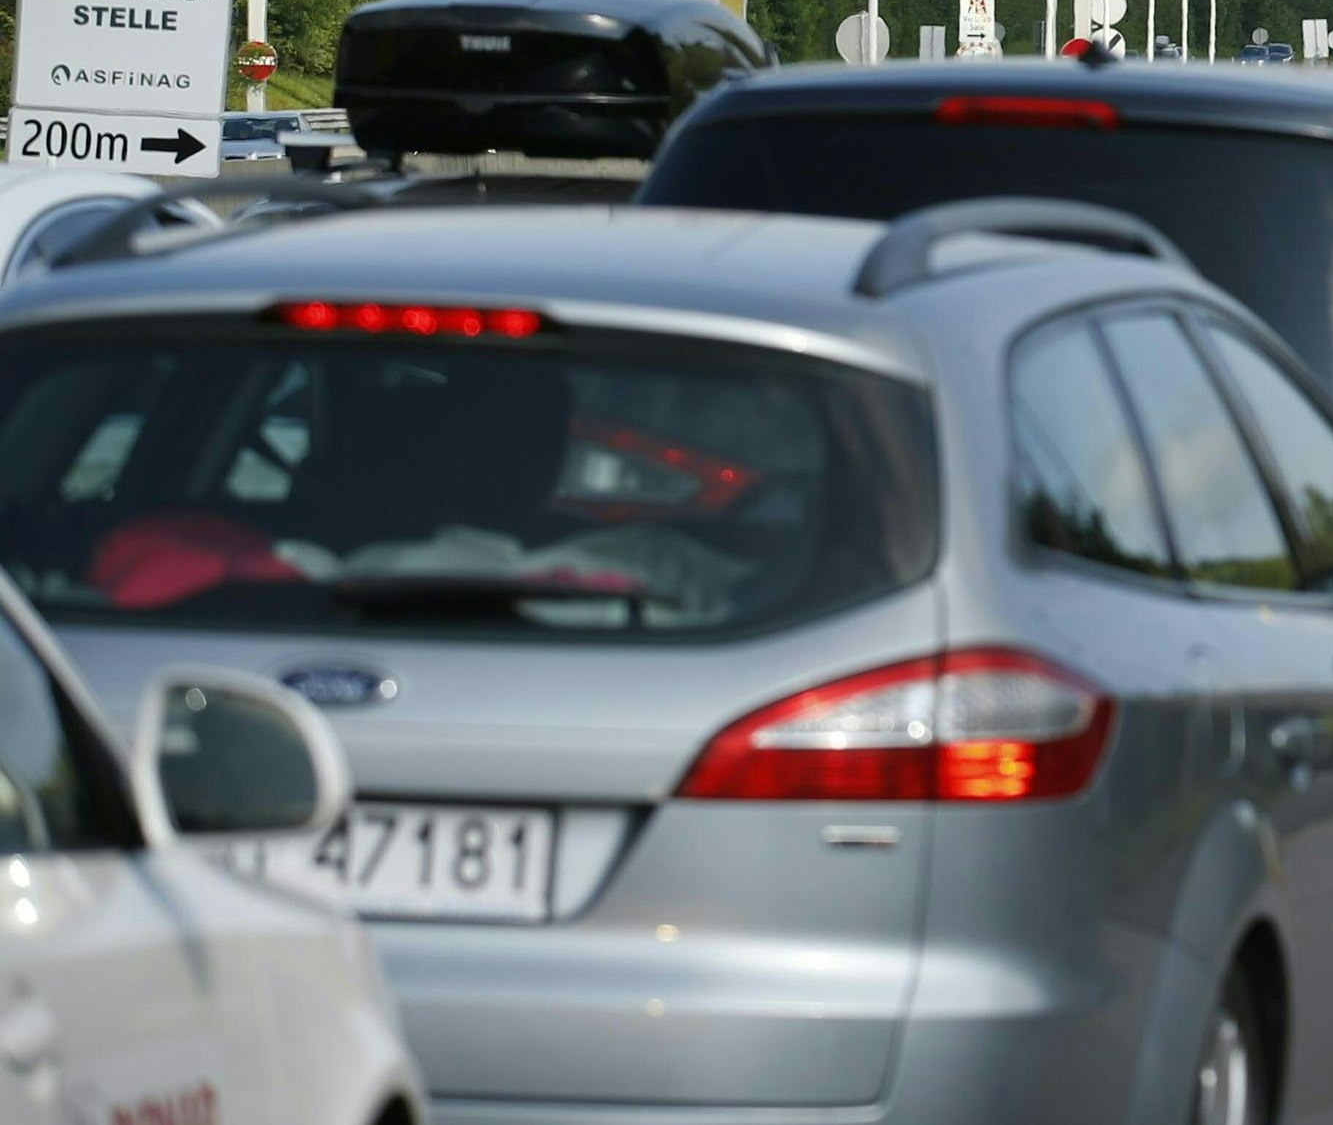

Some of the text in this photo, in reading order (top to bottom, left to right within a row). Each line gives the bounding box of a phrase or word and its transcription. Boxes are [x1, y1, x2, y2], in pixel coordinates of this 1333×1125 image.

[73, 5, 178, 31] STELLE
[22, 119, 128, 162] 200m
[314, 810, 527, 890] 47181
